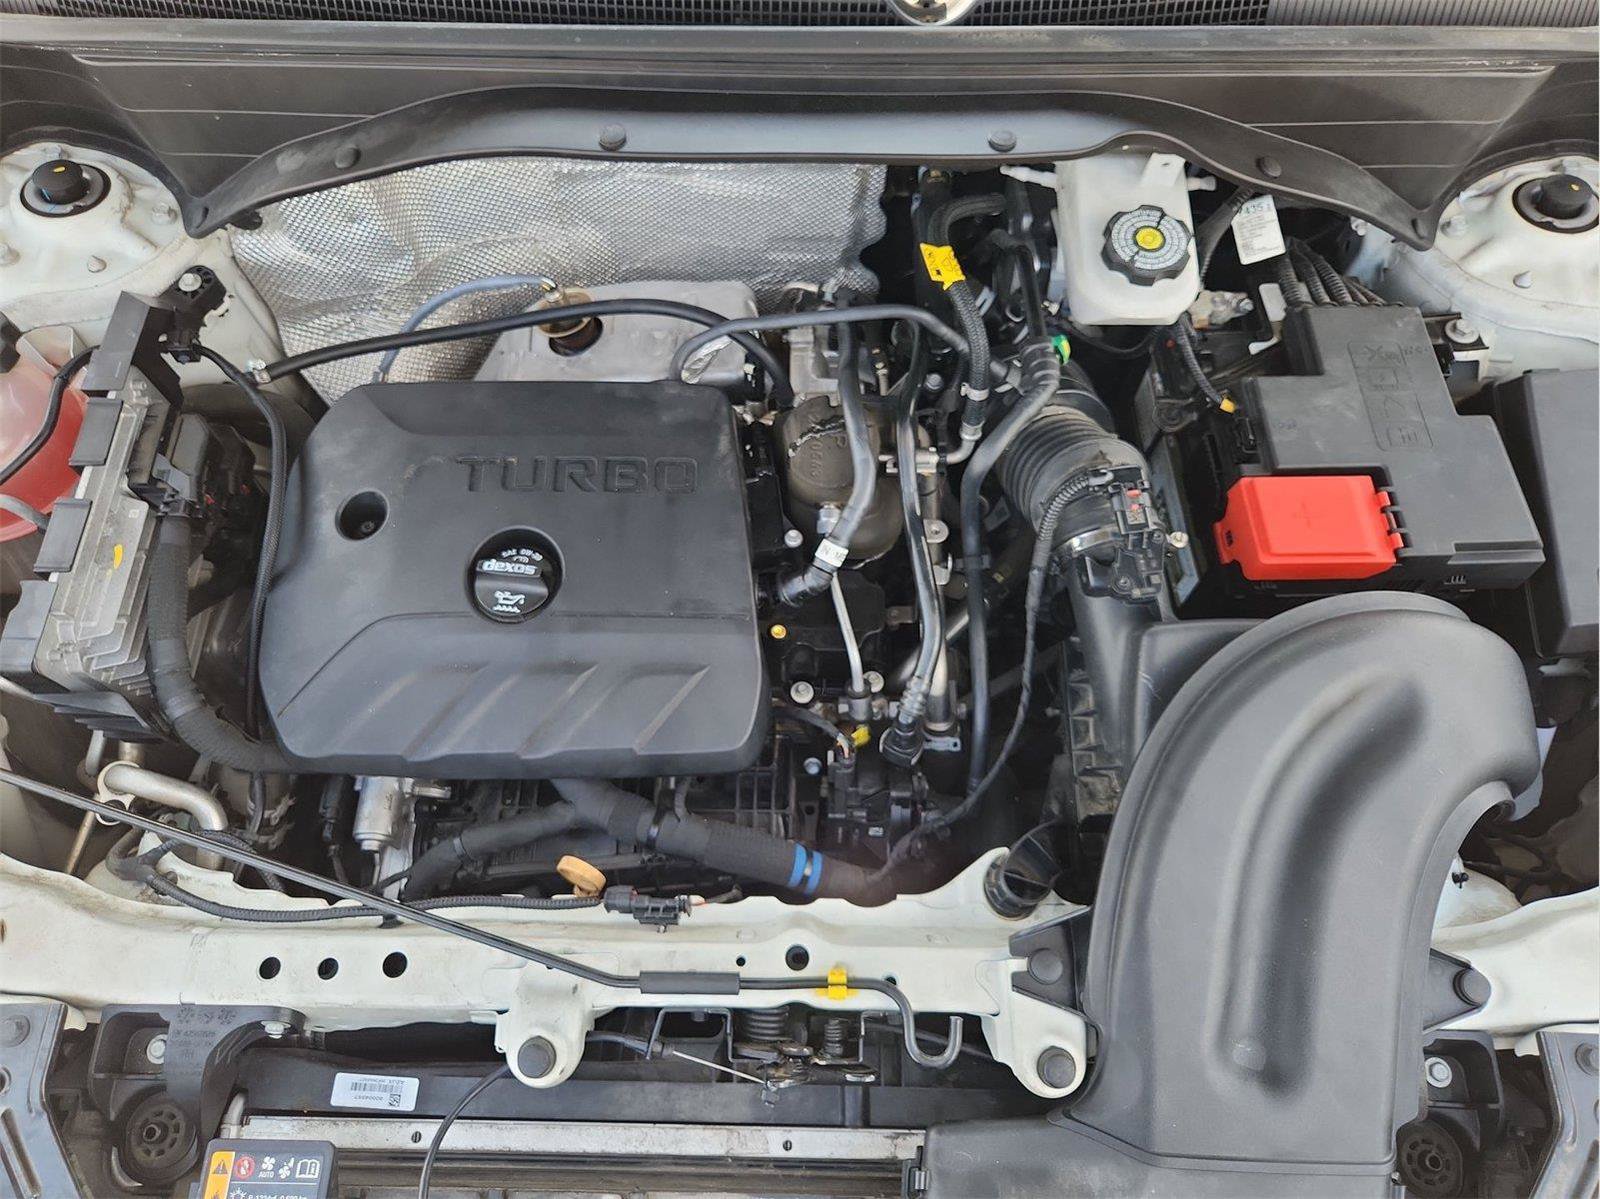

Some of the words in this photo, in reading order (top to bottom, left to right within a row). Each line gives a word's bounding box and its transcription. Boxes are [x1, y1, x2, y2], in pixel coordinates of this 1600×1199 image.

[456, 455, 698, 494] TURBO
[482, 558, 538, 575] dexos
[258, 1170, 275, 1178] AUTO
